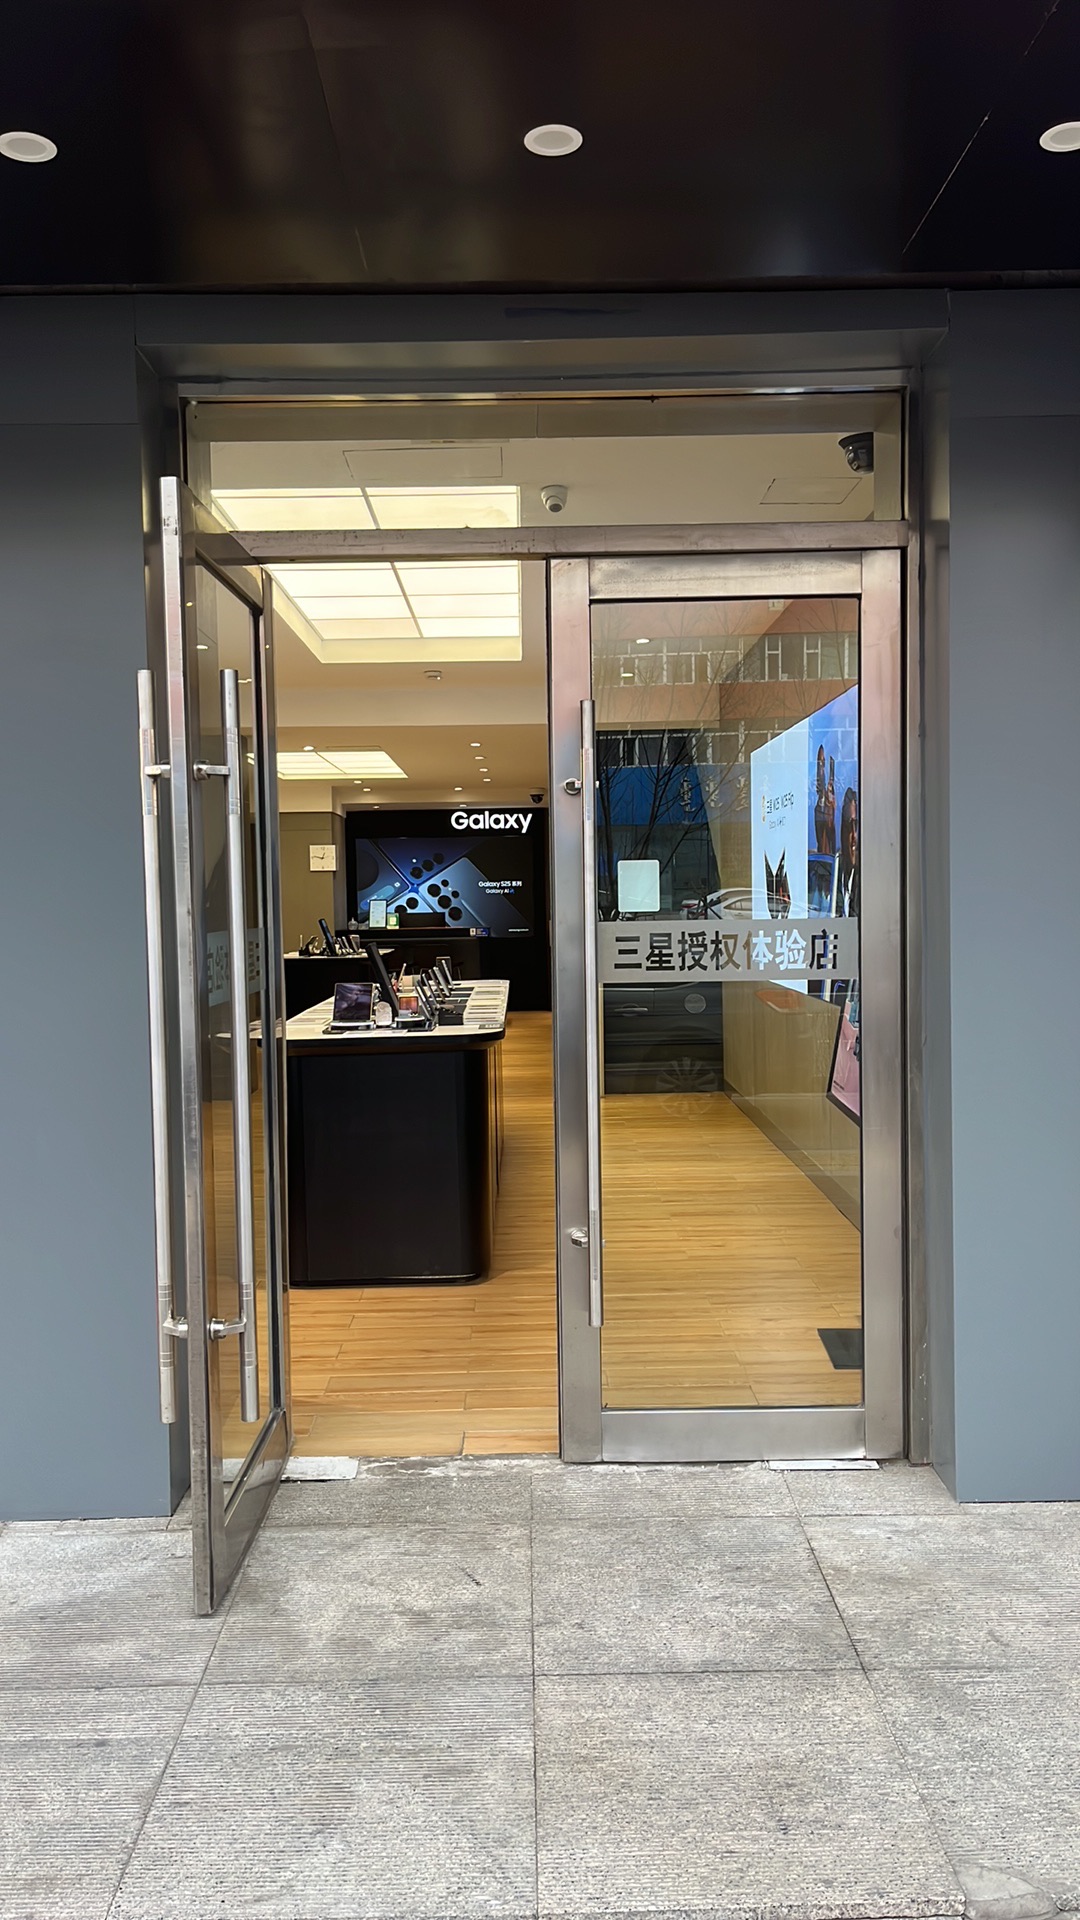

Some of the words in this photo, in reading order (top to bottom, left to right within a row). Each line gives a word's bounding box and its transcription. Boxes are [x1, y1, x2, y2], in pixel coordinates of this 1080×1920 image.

[450, 810, 533, 834] Galaxy
[614, 928, 839, 971] 三星授权体验店
